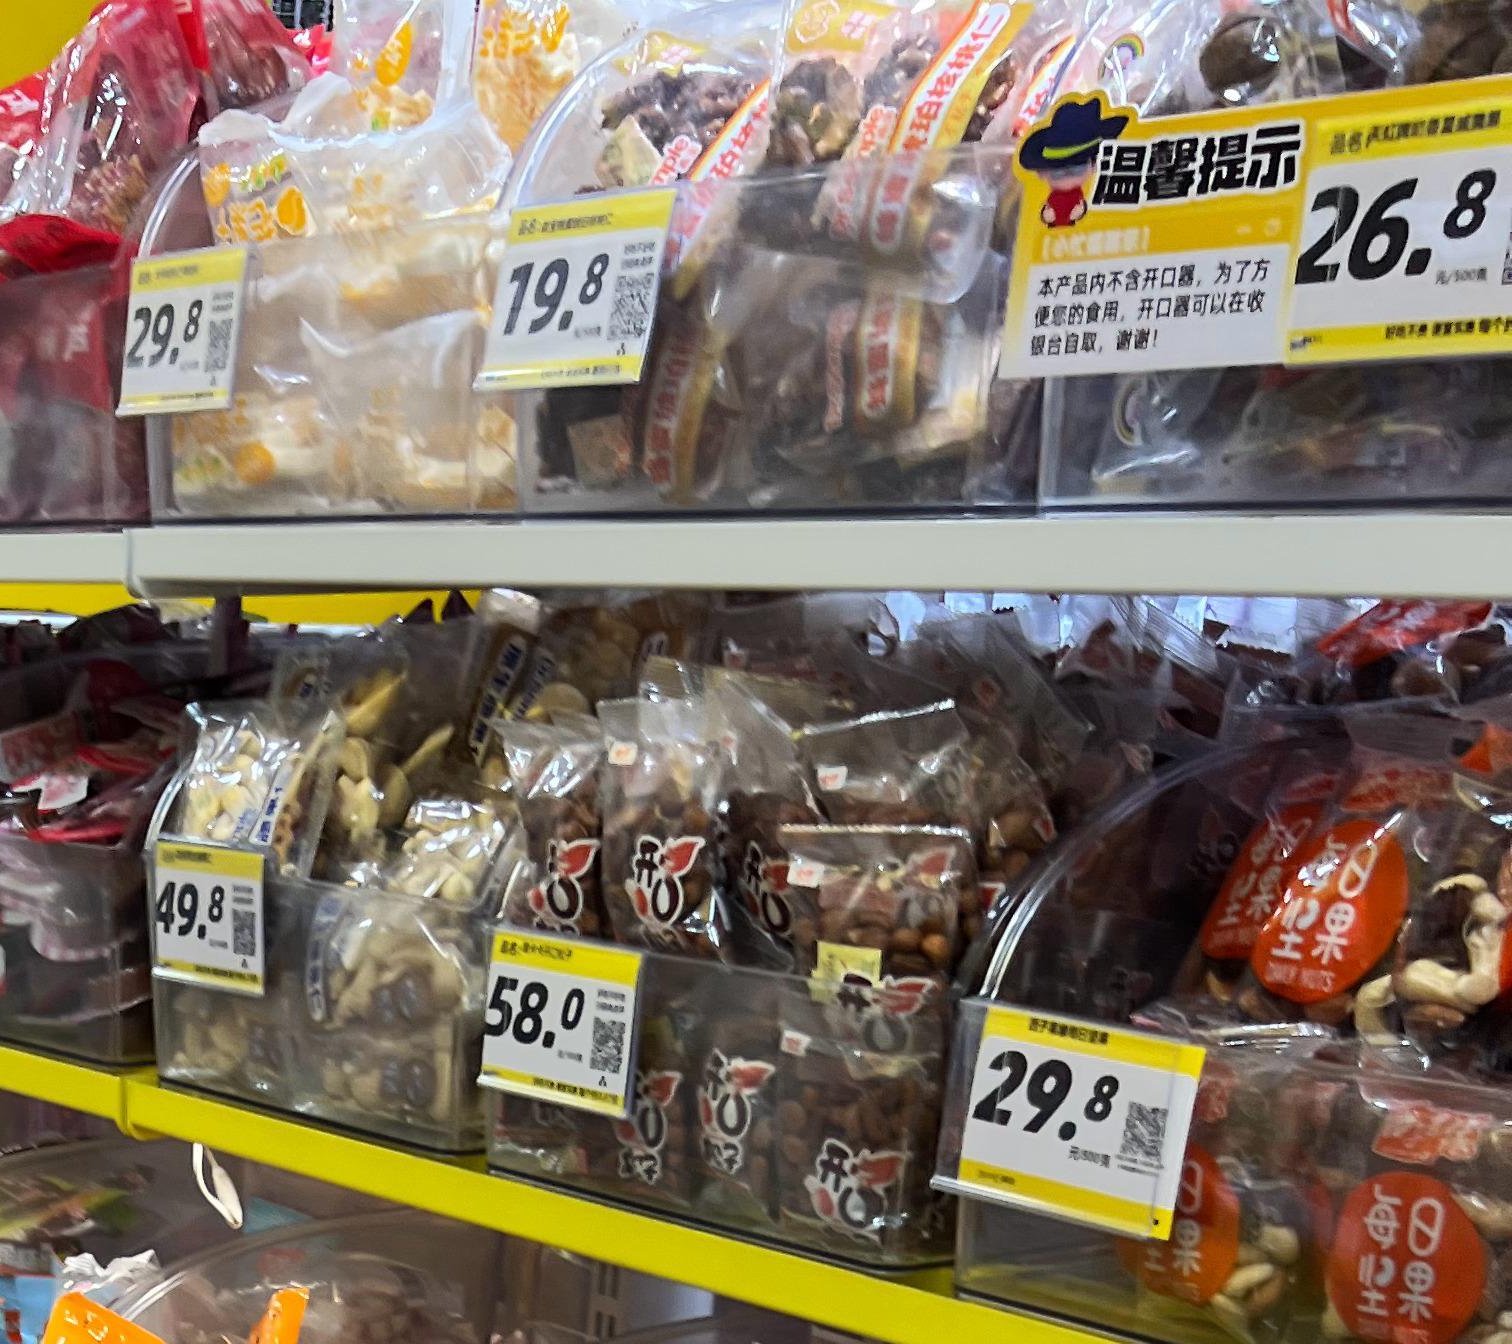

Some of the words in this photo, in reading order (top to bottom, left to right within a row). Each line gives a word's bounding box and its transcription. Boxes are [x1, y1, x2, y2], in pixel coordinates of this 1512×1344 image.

[1092, 123, 1301, 206] 温馨提示
[1294, 167, 1497, 285] 26.8
[126, 299, 203, 369] 29.8
[503, 253, 609, 336] 19.8
[156, 881, 224, 940] 49.8
[485, 975, 585, 1048] 58.0
[972, 1051, 1119, 1141] 29.8
